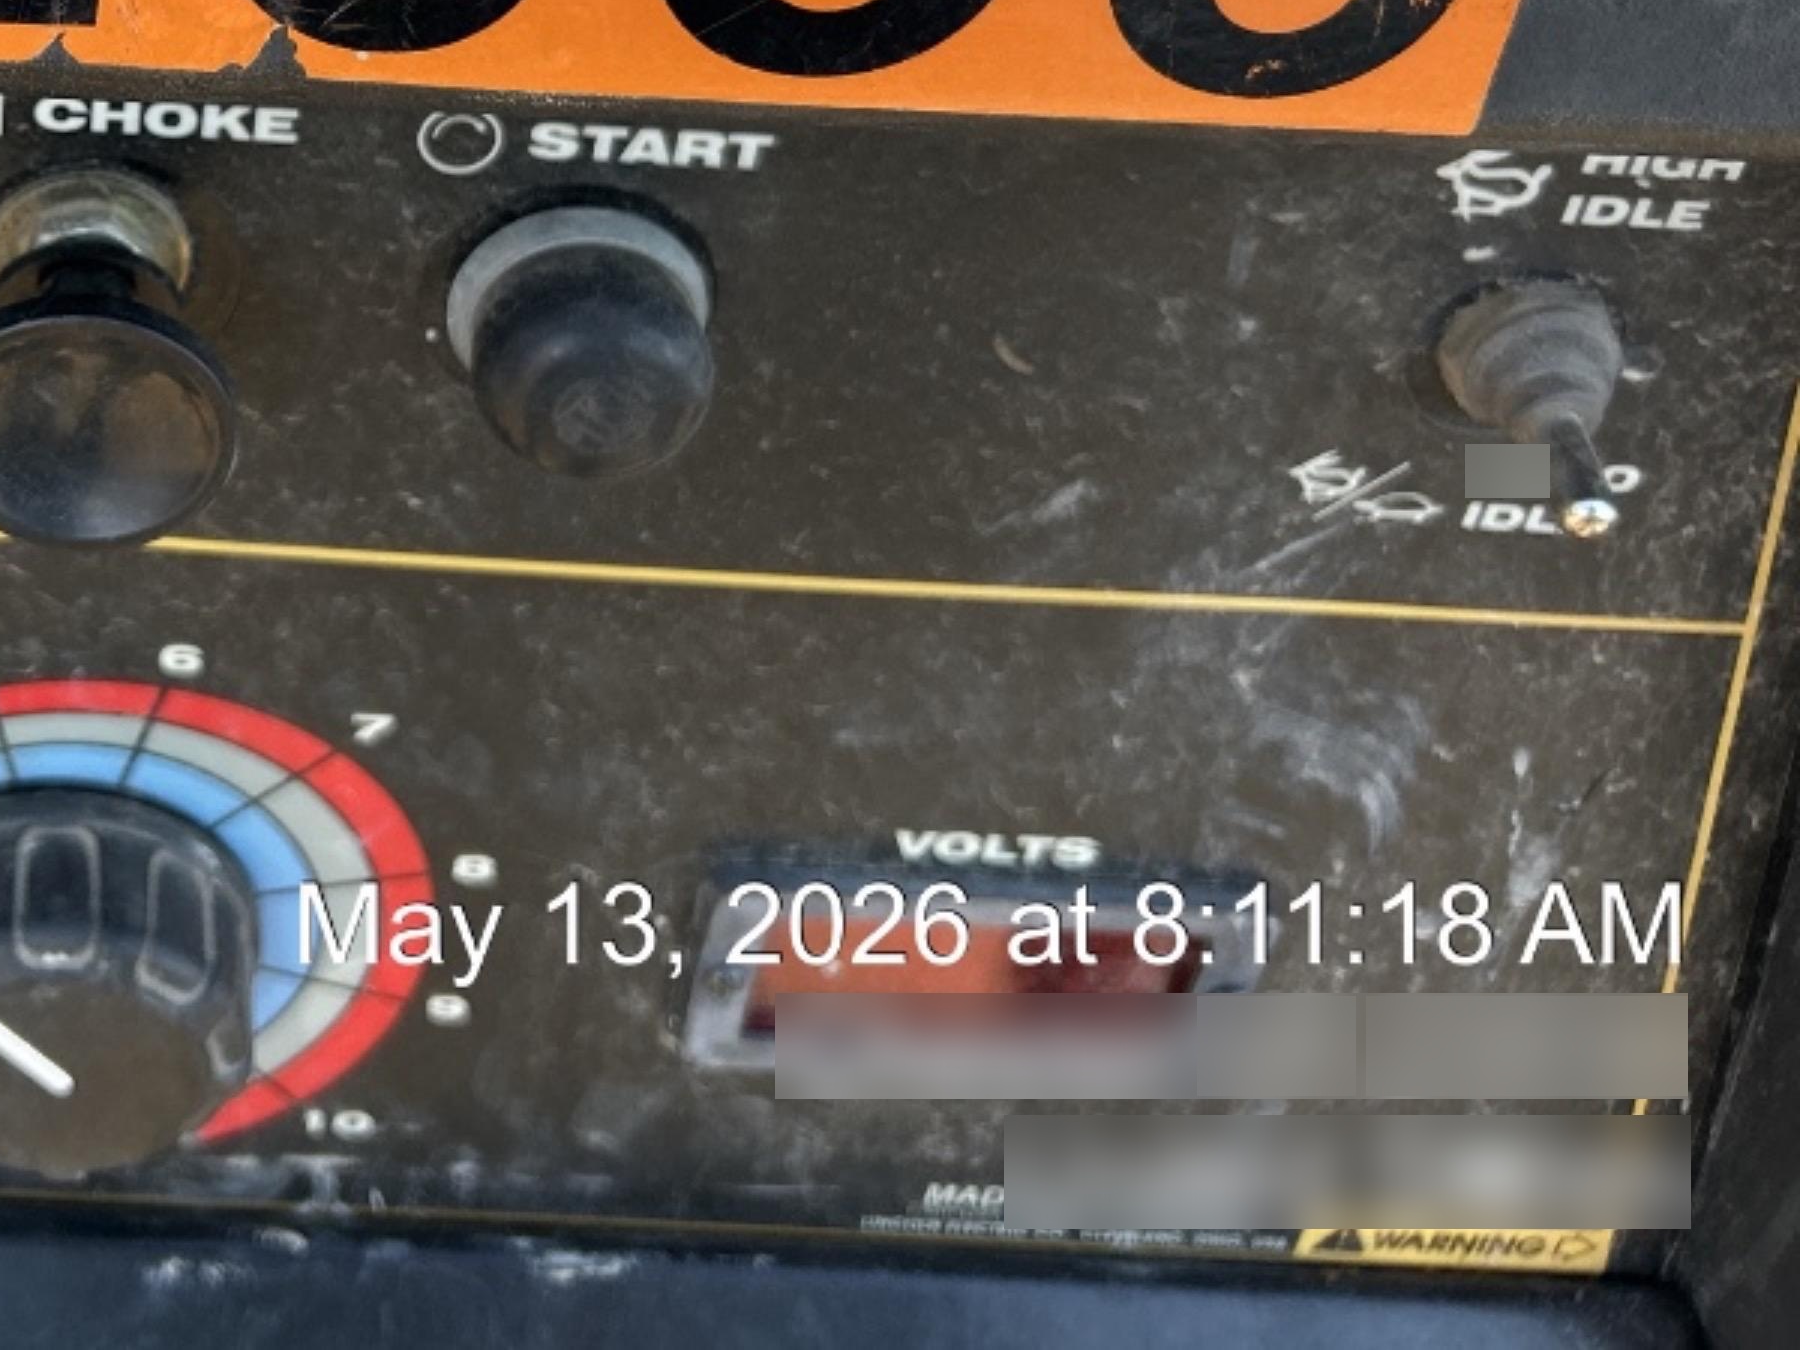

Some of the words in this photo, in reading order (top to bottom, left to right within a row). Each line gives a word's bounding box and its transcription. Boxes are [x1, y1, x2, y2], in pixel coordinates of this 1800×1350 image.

[32, 97, 301, 145] CHOKE
[528, 121, 776, 171] START
[1561, 194, 1711, 231] IDLE
[1460, 500, 1566, 536] IDL
[157, 643, 204, 678] 6
[349, 711, 397, 745] 7
[893, 828, 1104, 871] VOLTS
[452, 852, 498, 886] 8
[302, 1108, 378, 1141] 10
[1373, 1229, 1547, 1256] WARNING
